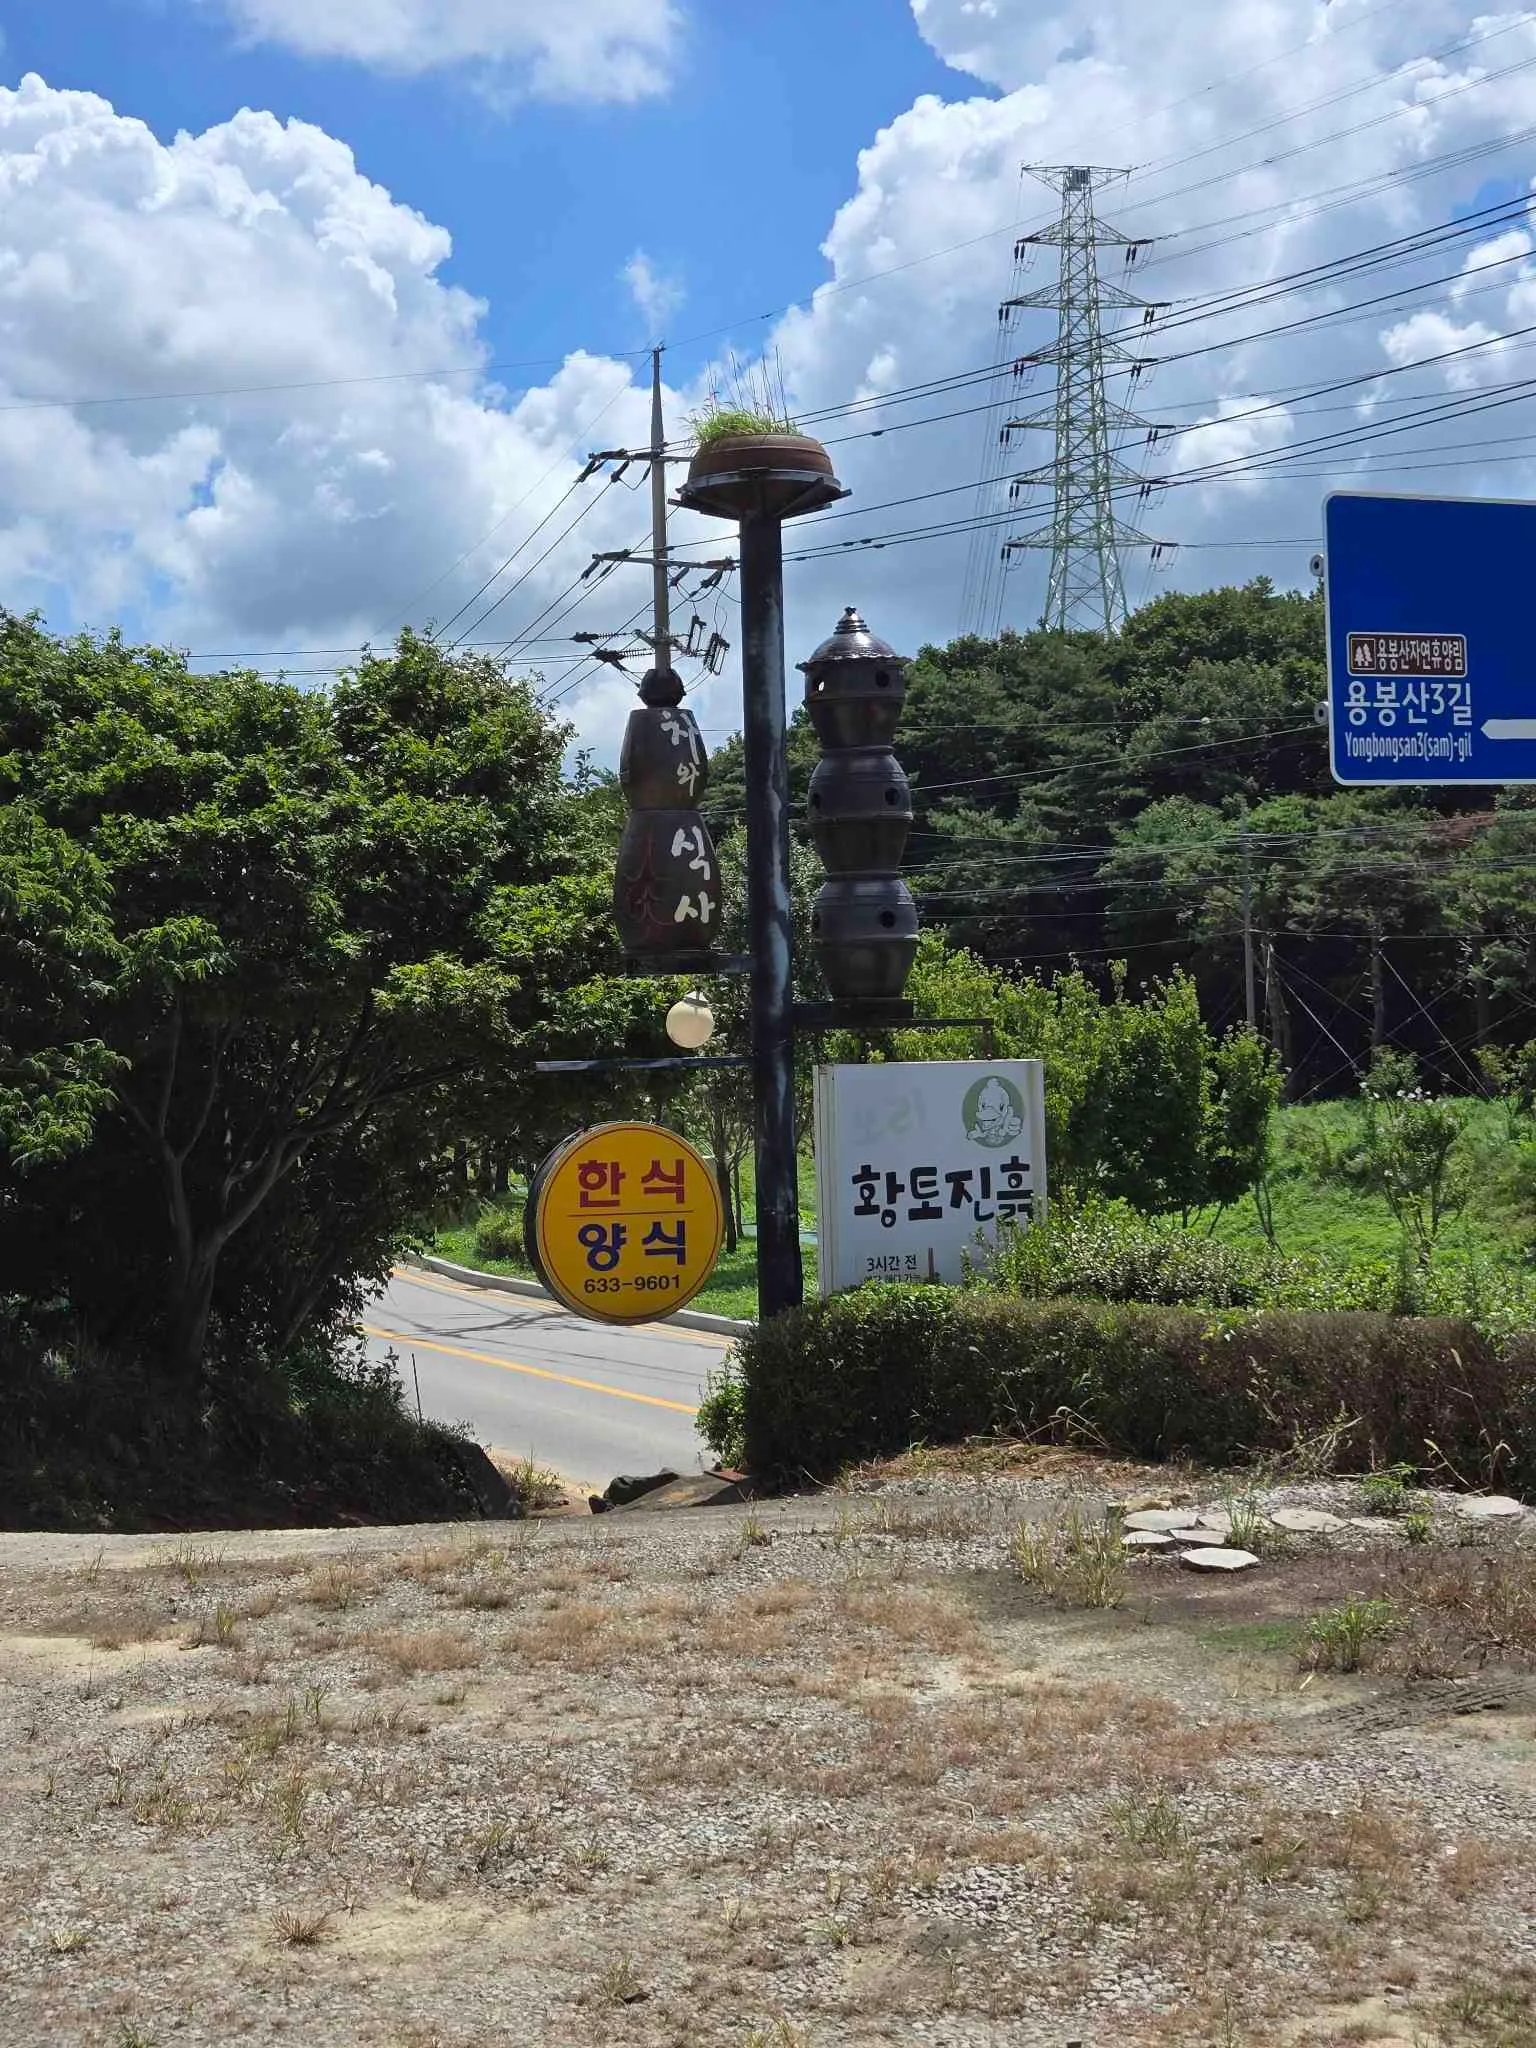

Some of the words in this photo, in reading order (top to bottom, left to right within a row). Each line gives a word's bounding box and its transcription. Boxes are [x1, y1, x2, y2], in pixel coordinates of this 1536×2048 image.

[1376, 638, 1464, 671] 용봉산자연휴양림
[1343, 680, 1473, 727] 용봉산3길
[671, 825, 716, 924] 식사
[576, 1158, 686, 1208] 한식
[851, 1155, 1035, 1228] 황토진흙
[577, 1219, 687, 1272] 양식
[866, 1255, 900, 1272] 3시간
[904, 1254, 918, 1270] 전
[583, 1274, 681, 1294] 633-9601
